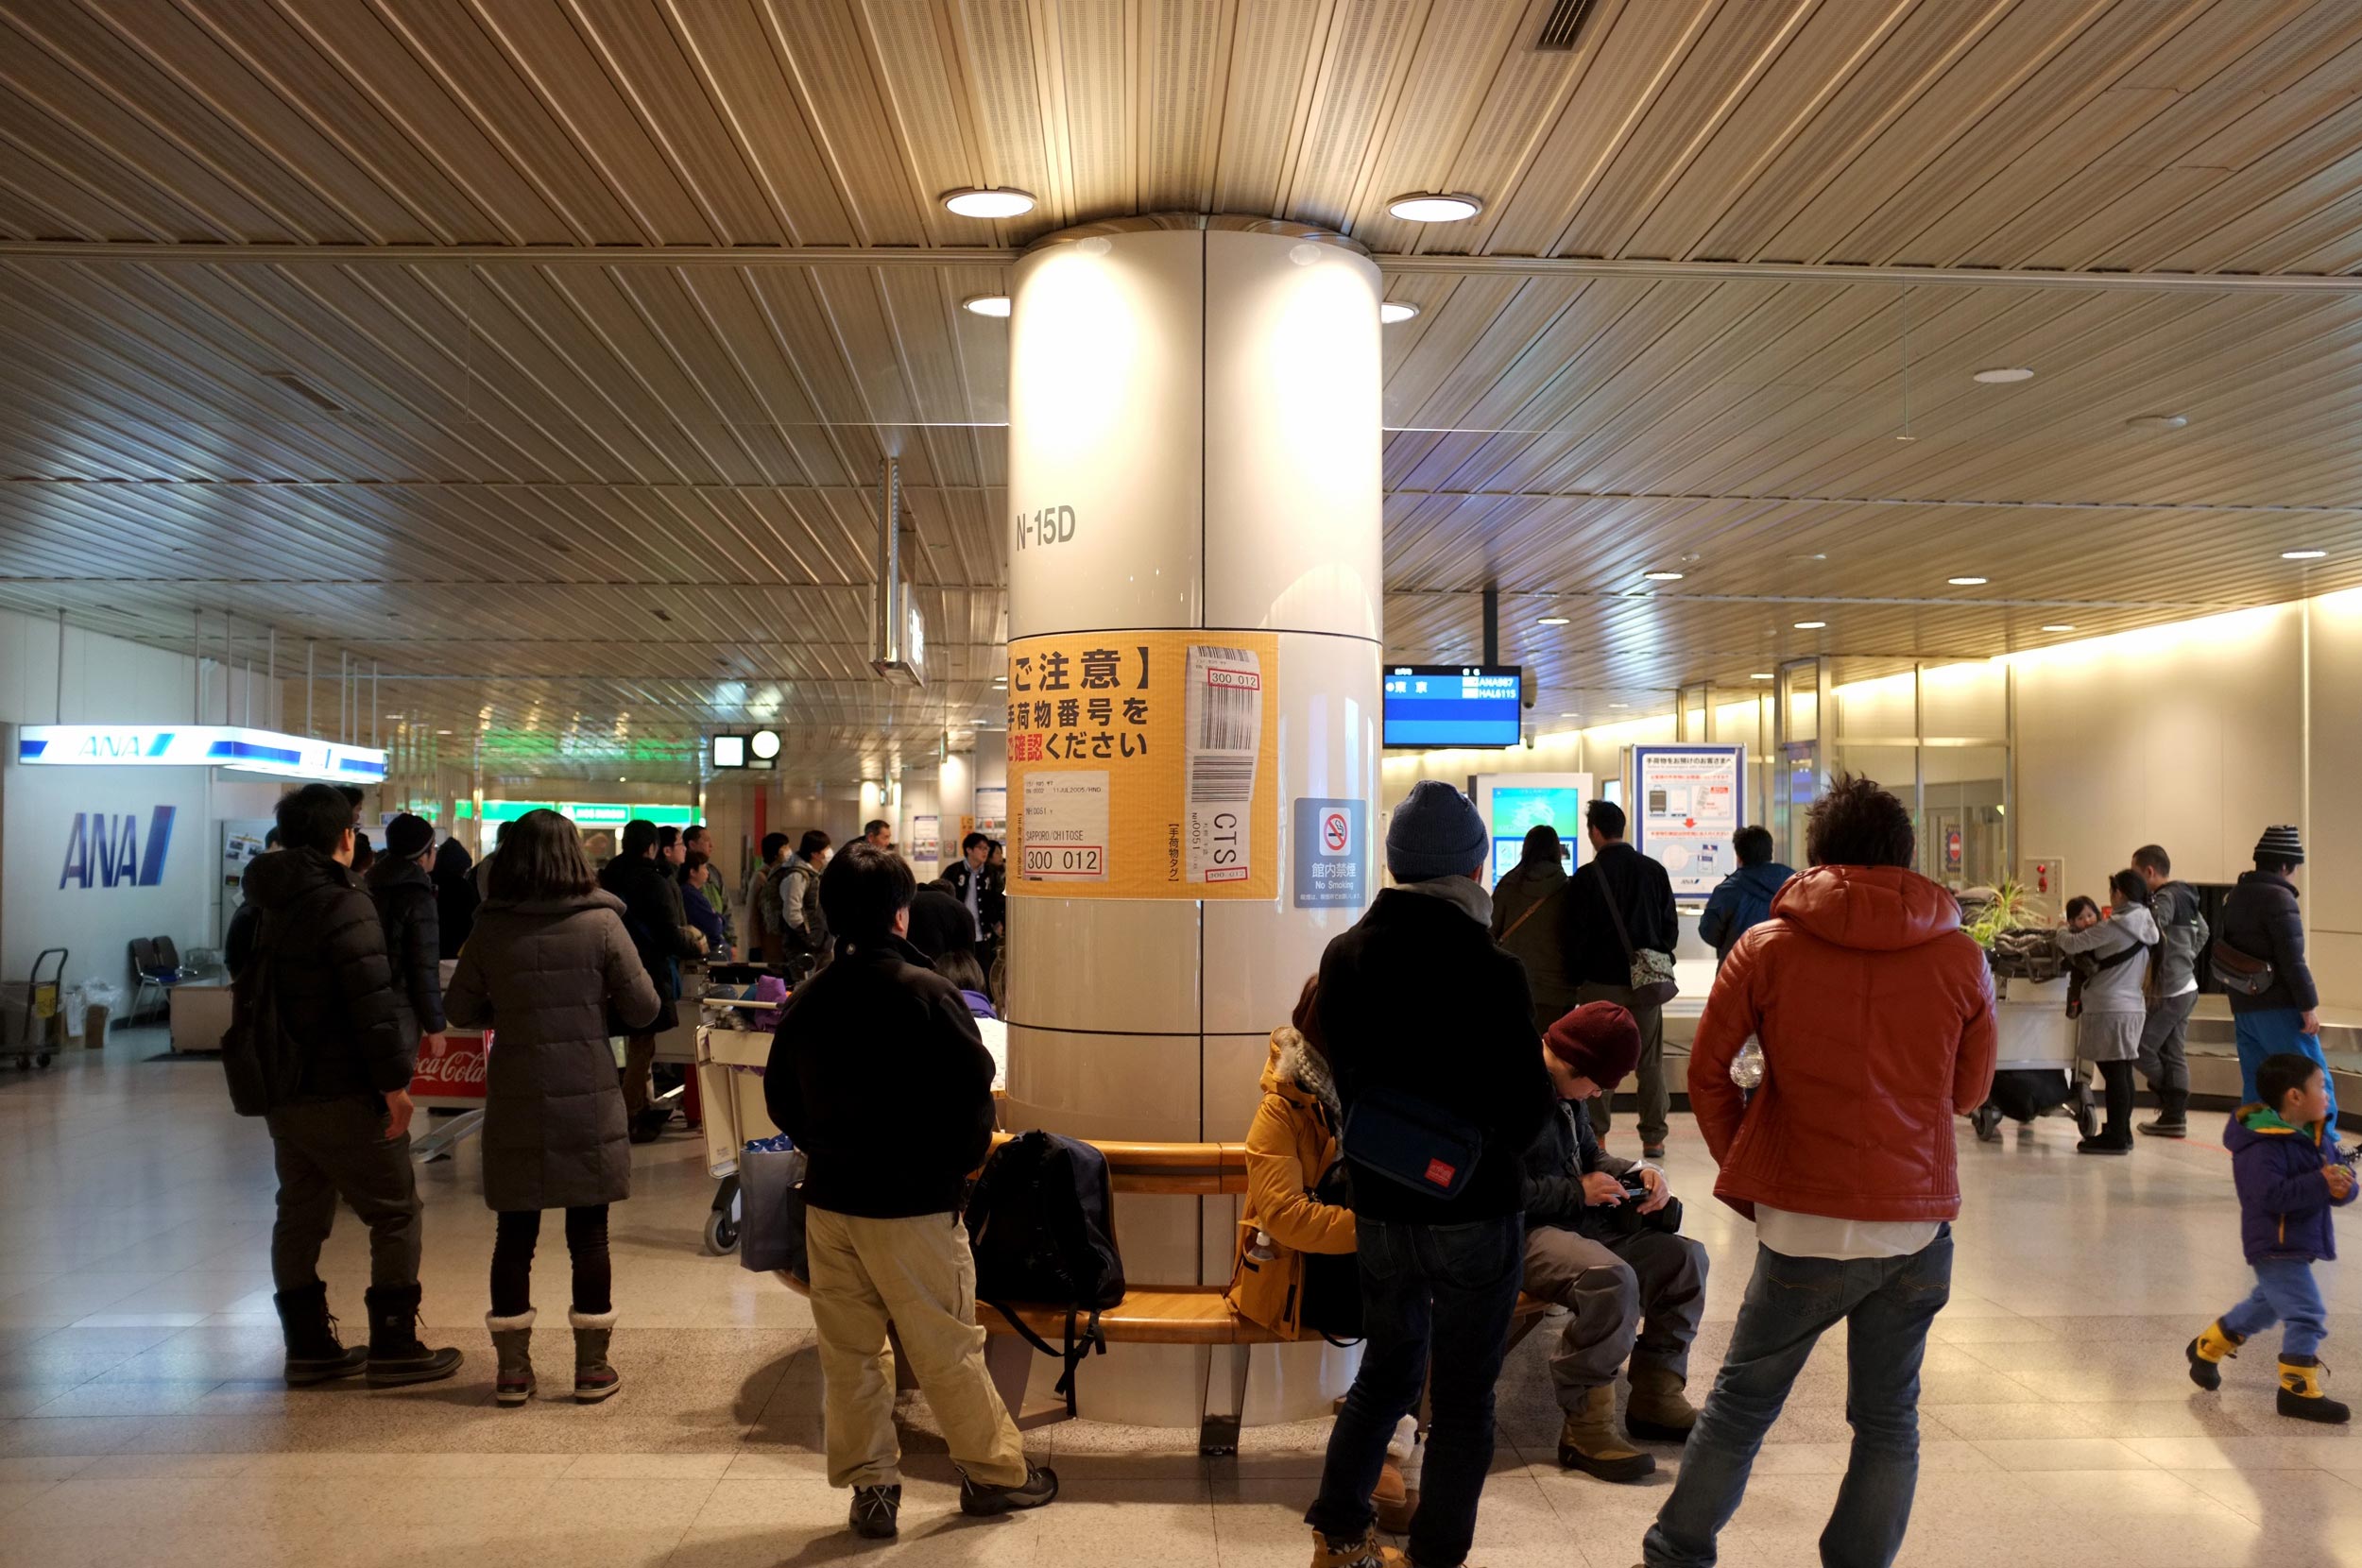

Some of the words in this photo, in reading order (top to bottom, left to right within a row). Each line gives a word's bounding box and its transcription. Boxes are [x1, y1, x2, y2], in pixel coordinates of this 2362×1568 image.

[1017, 504, 1076, 552] N-15D
[1211, 673, 1232, 684] 300
[1238, 674, 1257, 687] 012
[1008, 697, 1149, 731] 手荷物番号を
[78, 735, 140, 757] ANA
[1025, 830, 1084, 842] SAPPORO/CHITOSE
[1214, 813, 1237, 864] CTS
[59, 812, 136, 890] ANA
[1027, 851, 1053, 870] 300
[1063, 851, 1097, 870] 012
[1311, 862, 1357, 878] 館内禁煙
[1315, 880, 1326, 890] No
[1327, 880, 1354, 891] Smoking
[414, 1051, 487, 1083] ca-Cola
